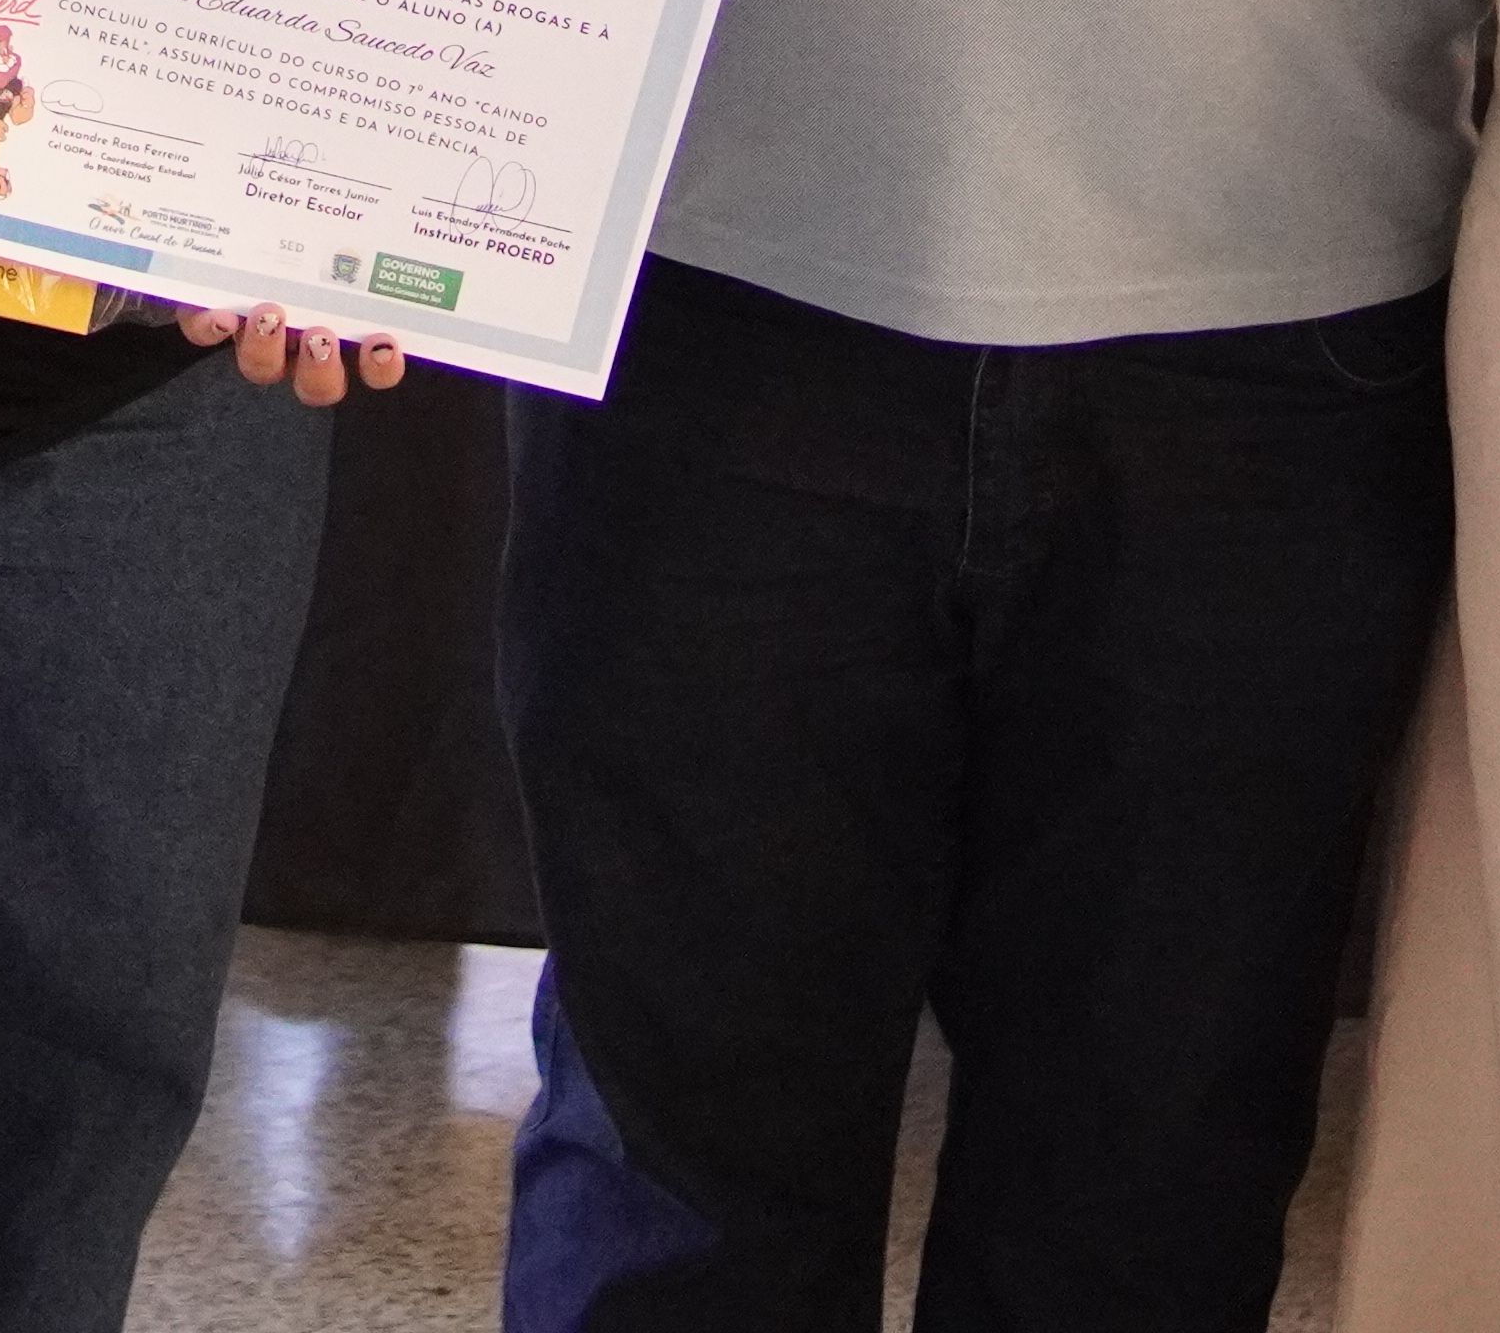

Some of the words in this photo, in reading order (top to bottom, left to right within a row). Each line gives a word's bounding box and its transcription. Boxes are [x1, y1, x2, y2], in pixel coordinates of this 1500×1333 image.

[474, 17, 503, 37] (A)
[492, 0, 573, 30] DROGAS
[579, 21, 592, 35] E
[597, 23, 609, 41] À
[154, 21, 168, 34] O
[174, 26, 273, 60] CURRÍCULO
[279, 52, 305, 68] DO
[311, 60, 369, 83] CURSO
[376, 75, 401, 92] DO
[428, 90, 467, 108] ANO
[324, 19, 434, 61] Saucedo
[439, 44, 496, 79] Vaz
[67, 23, 90, 40] NA
[158, 46, 262, 80] ASSUMINDO
[268, 72, 282, 84] O
[288, 77, 416, 118] COMPROMISSO
[423, 109, 497, 139] PESSOAL
[505, 130, 528, 146] DE
[100, 55, 149, 77] FICAR
[155, 68, 216, 93] LONGE
[222, 83, 256, 102] DAS
[262, 93, 333, 121] DROGAS
[338, 112, 349, 125] E
[355, 116, 378, 132] DA
[387, 123, 480, 157] VIOLÊNCIA
[52, 124, 108, 145] Alexandre
[112, 136, 139, 152] Rosa
[97, 164, 152, 183] PROERD/MS
[269, 170, 302, 186] César
[306, 178, 341, 196] Torres
[345, 188, 380, 205] Junior
[245, 183, 301, 207] Diretor
[306, 196, 364, 221] Escolar
[279, 239, 305, 253] SED
[413, 222, 480, 248] Instrutor
[485, 238, 555, 266] PROERD
[437, 211, 479, 229] Evandro
[483, 223, 536, 243] Fernandes
[540, 236, 571, 251] Pache
[378, 269, 396, 281] DO
[398, 274, 445, 293] ESTADO
[382, 258, 440, 280] GOVERNO
